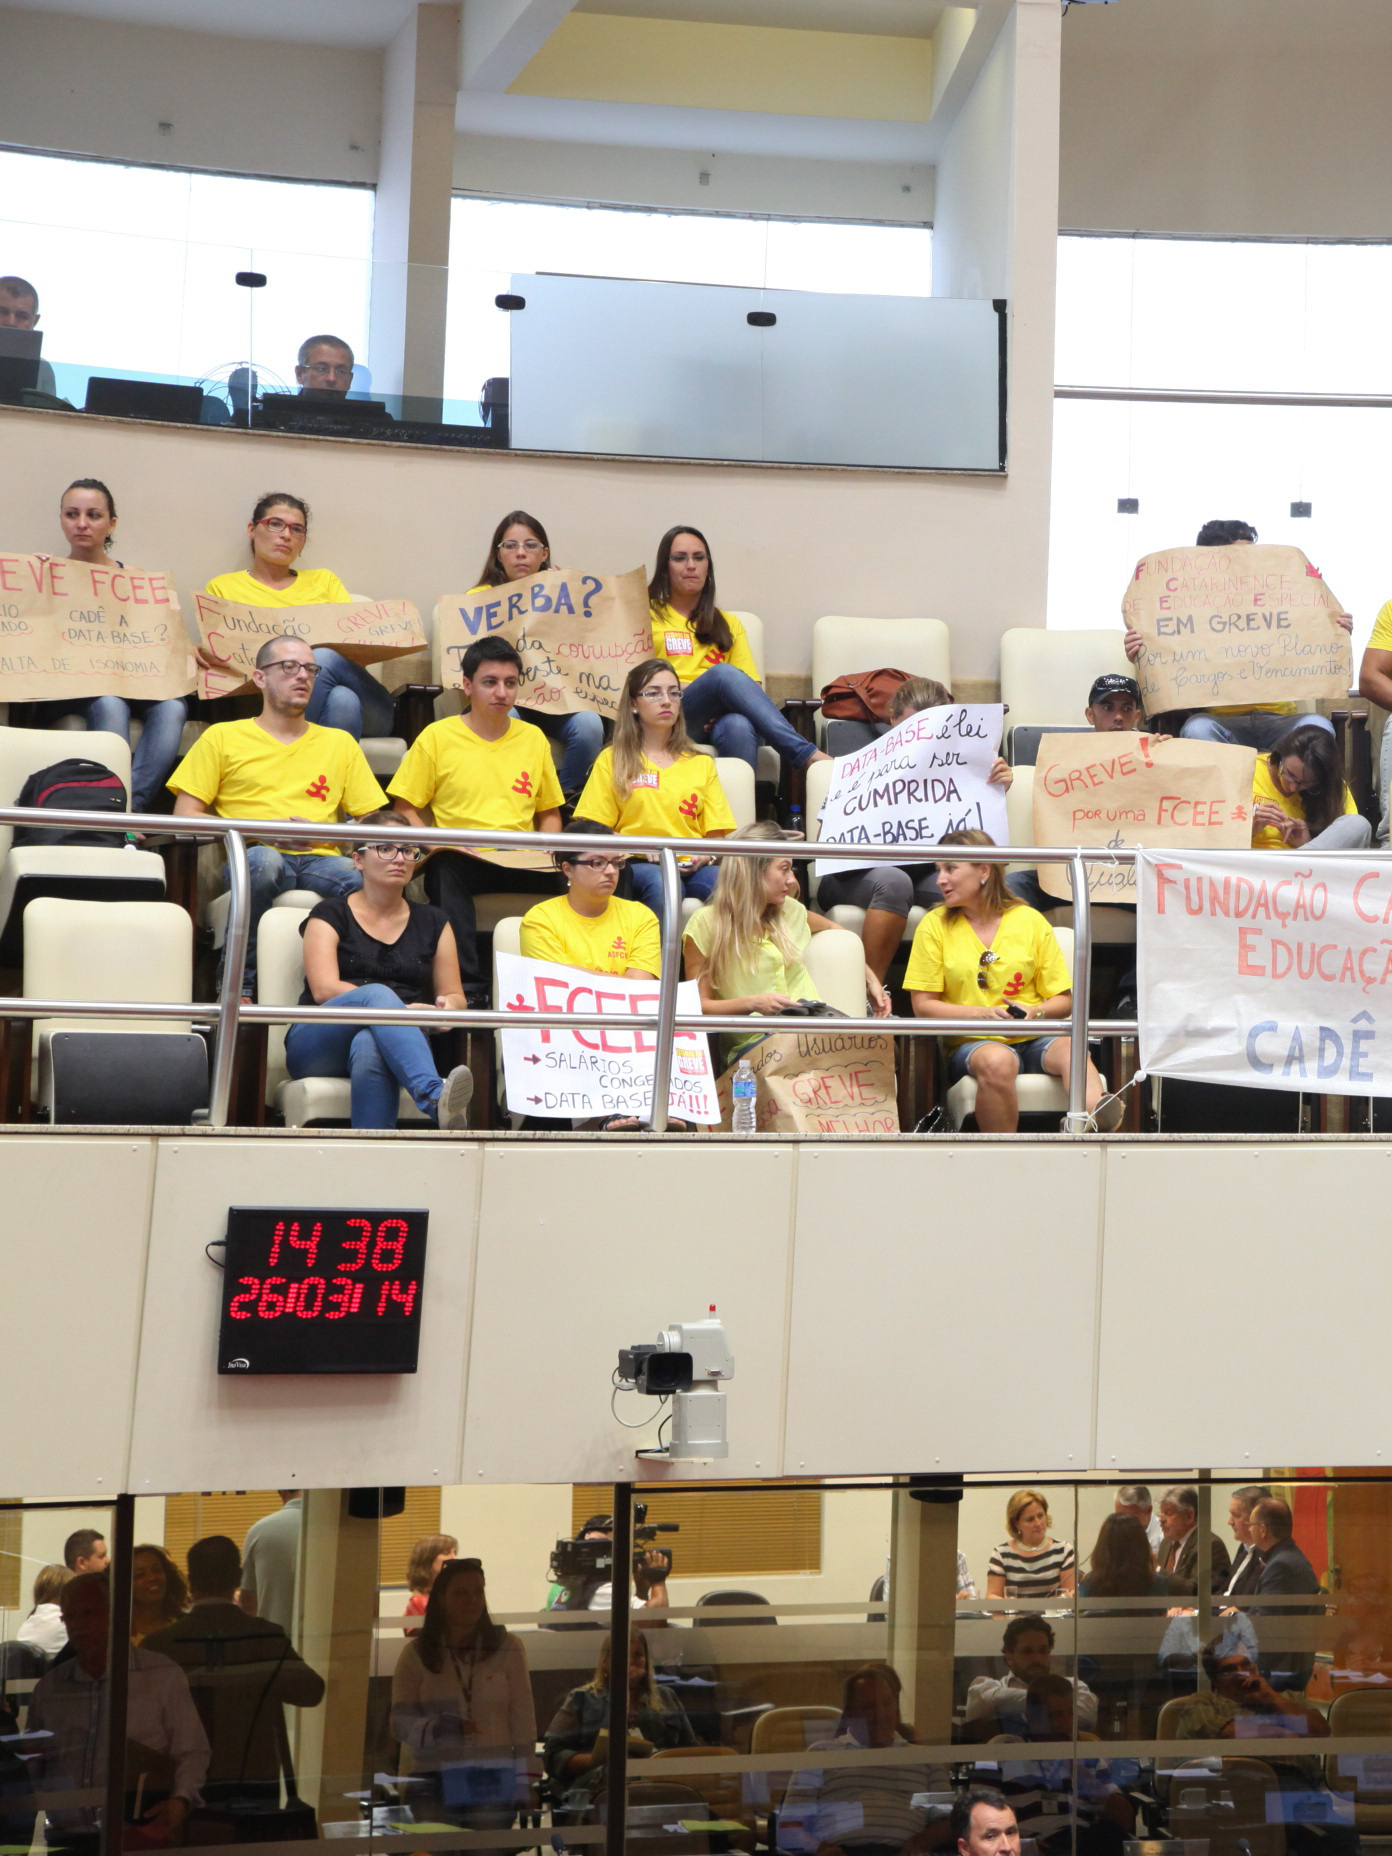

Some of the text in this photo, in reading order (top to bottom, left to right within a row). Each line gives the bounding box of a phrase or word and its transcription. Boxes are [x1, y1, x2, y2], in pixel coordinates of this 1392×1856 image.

[0, 558, 170, 604] EVE FCEE
[1135, 551, 1231, 581] FUNDAÇÃO
[69, 606, 129, 628] CADÊ A
[459, 576, 603, 635] VERBA?
[1160, 594, 1243, 613] EDUCAÇÃO
[1254, 593, 1336, 610] ESPECIAL
[1156, 611, 1291, 636] EM GREVE
[1223, 643, 1273, 659] novo
[1278, 634, 1344, 657] Plano
[1, 656, 160, 673] ALTA DE ISONOMIA
[841, 718, 934, 779] DATA-BASE
[957, 708, 988, 739] lei
[868, 755, 916, 787] para
[929, 752, 967, 769] ser
[1044, 736, 1154, 798] GREVE!
[843, 777, 962, 817] CUMPRIDA
[1106, 809, 1146, 822] uma
[1157, 796, 1226, 827] FCEE
[826, 816, 934, 844] DATA-BASE
[1155, 863, 1329, 929] FUNDAÇÃO
[545, 1050, 634, 1075] SALÁRIOS
[1245, 1009, 1376, 1083] CADÊ
[544, 1092, 593, 1110] DATA
[602, 1090, 653, 1110] BASE
[792, 1069, 878, 1106] GREVE
[268, 1218, 410, 1272] 14 38
